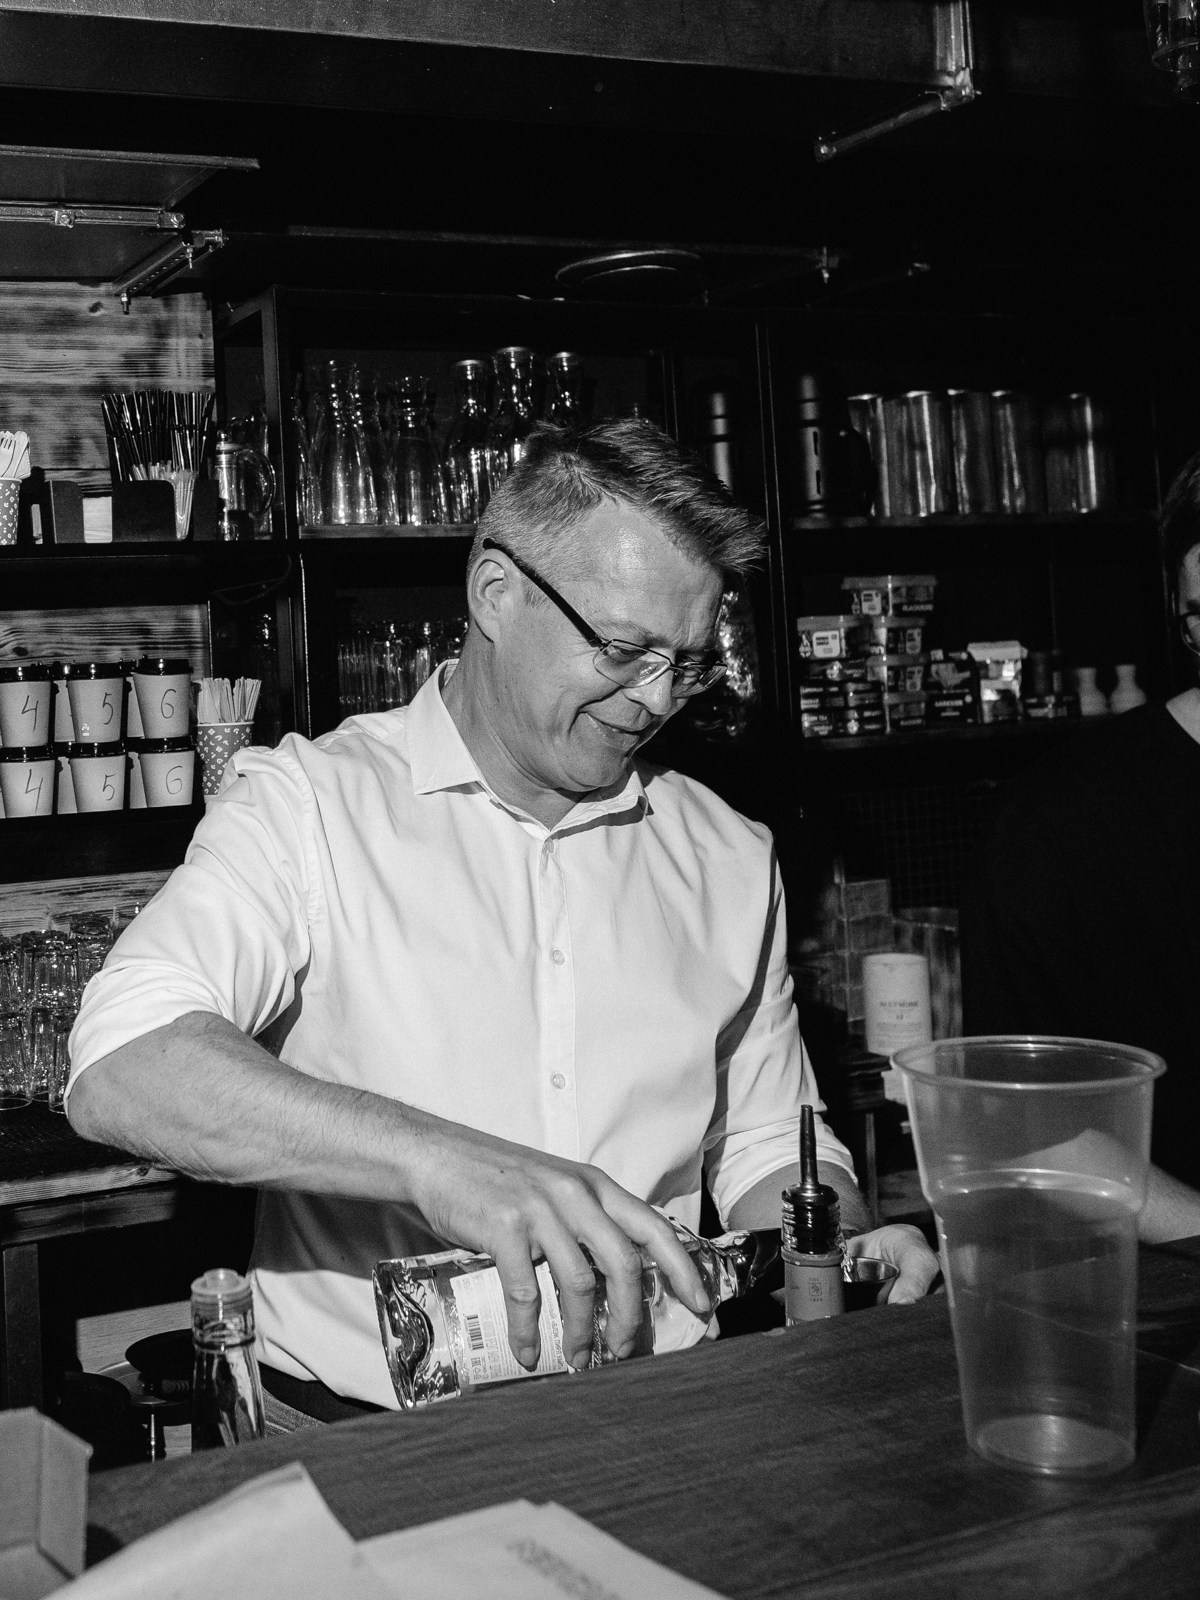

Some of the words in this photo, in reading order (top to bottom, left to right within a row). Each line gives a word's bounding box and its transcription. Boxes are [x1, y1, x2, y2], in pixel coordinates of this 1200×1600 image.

[21, 694, 39, 732] 4
[102, 691, 114, 725] 5
[160, 688, 176, 719] 6
[24, 768, 44, 813] 4
[102, 773, 116, 801] 5
[165, 765, 183, 795] 6
